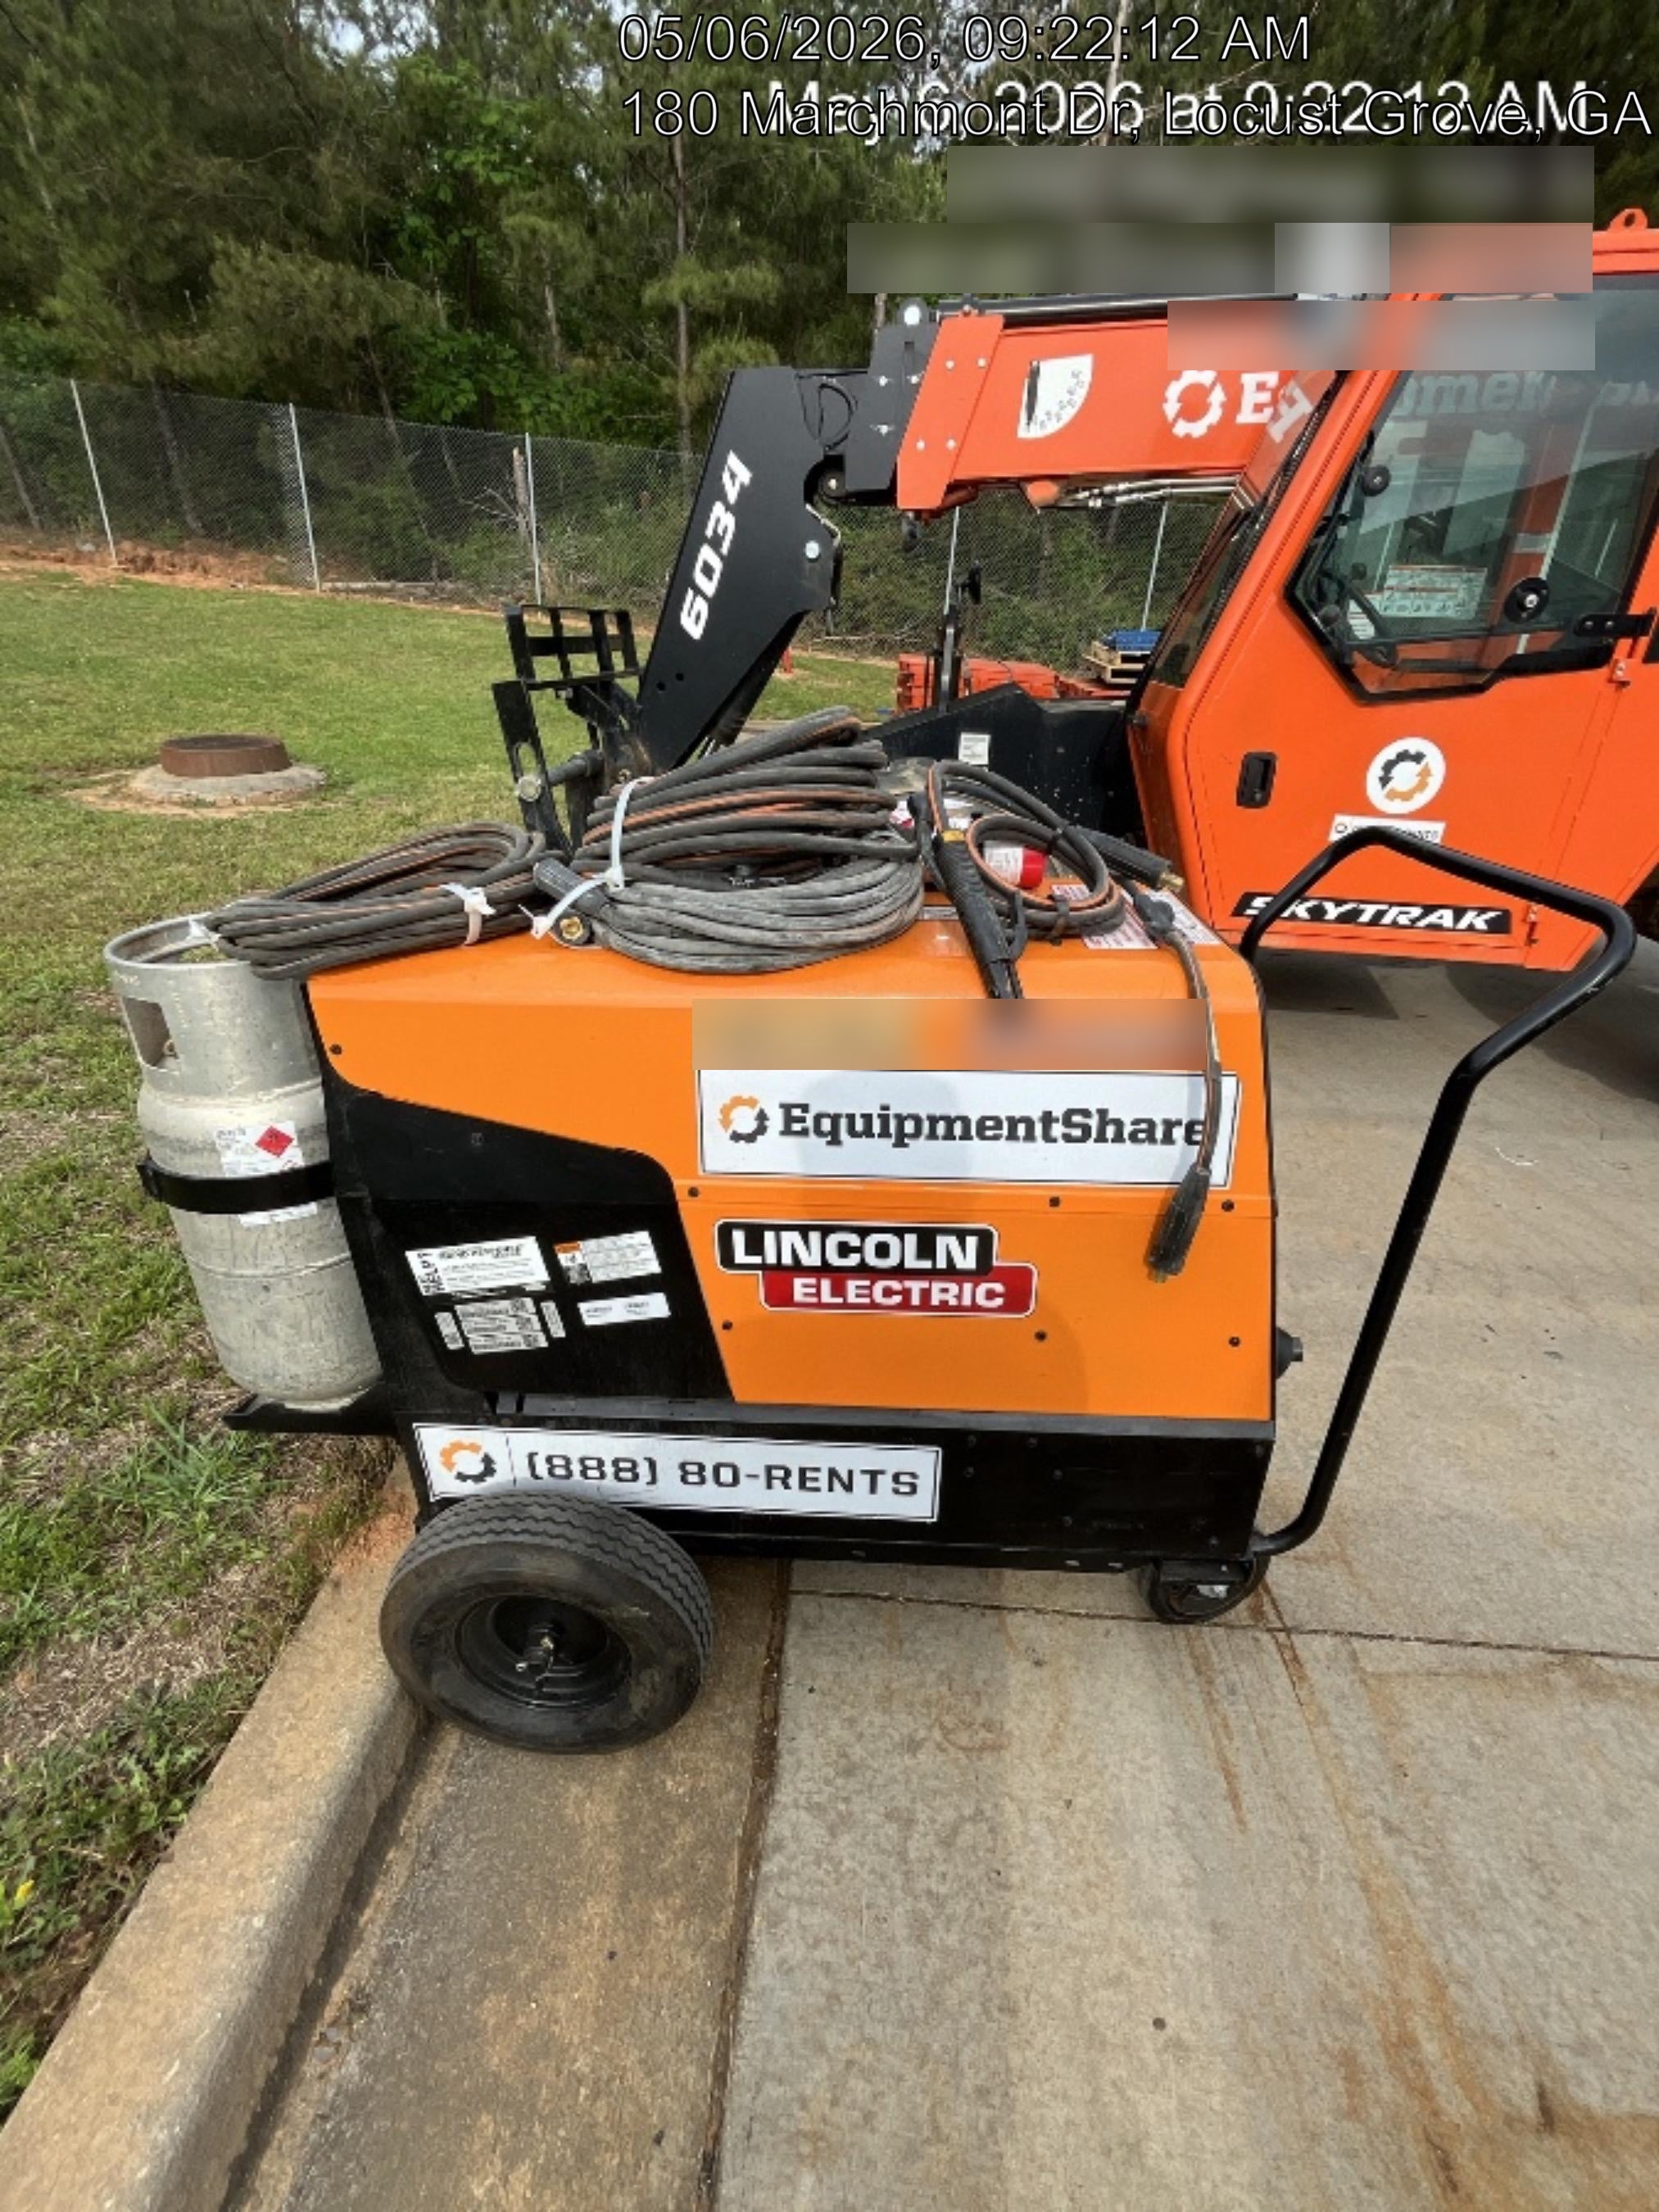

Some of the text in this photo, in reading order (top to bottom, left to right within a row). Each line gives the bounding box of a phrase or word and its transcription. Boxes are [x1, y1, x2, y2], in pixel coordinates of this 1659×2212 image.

[679, 450, 753, 641] 6034
[777, 1102, 1206, 1149] EquipmentShare
[732, 1229, 980, 1271] LINCOLN
[792, 1277, 1006, 1308] ELECTRIC
[527, 1451, 919, 1497] (888) 80-RENTS
